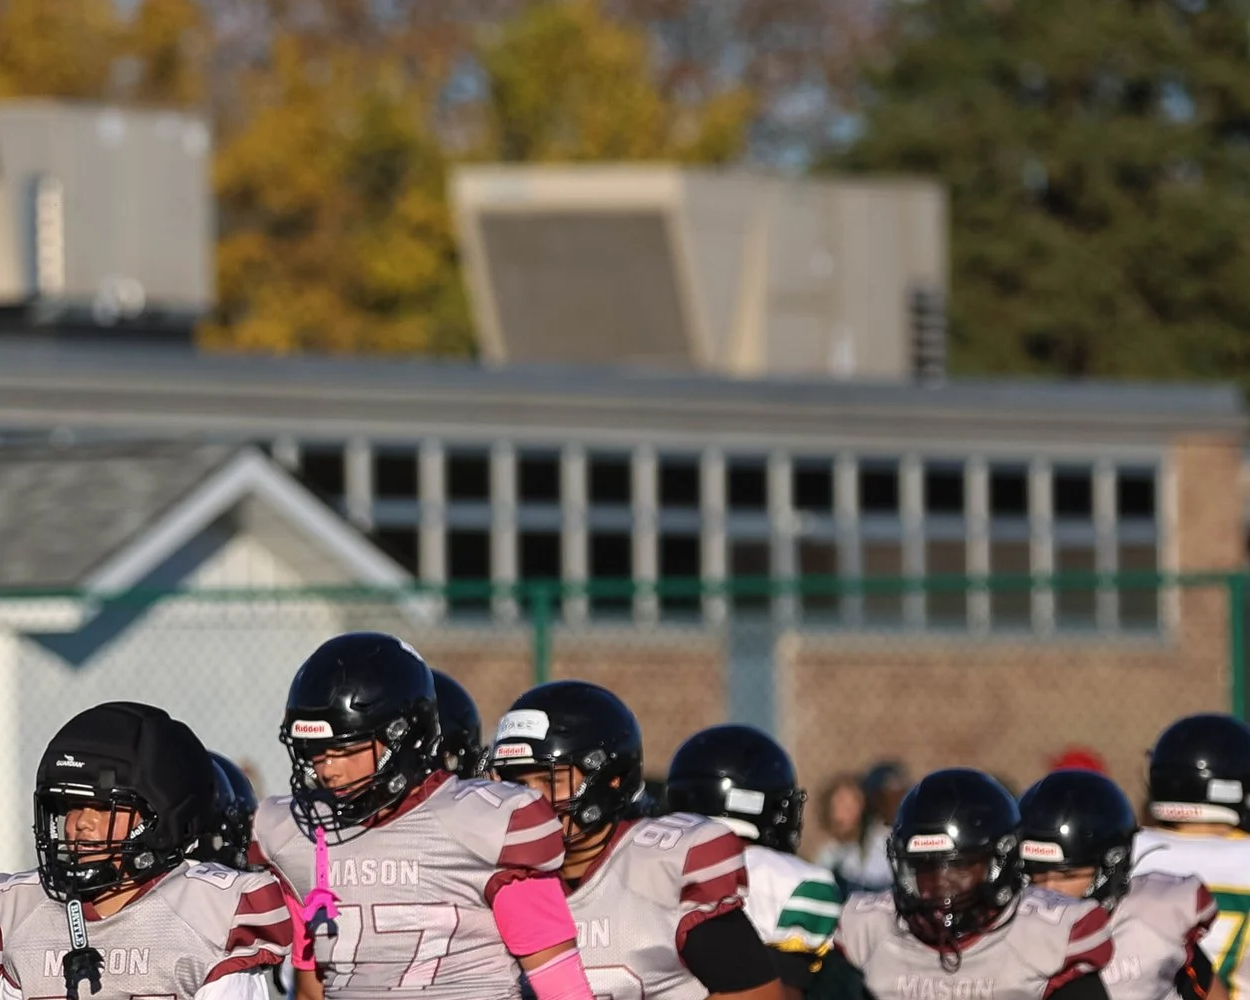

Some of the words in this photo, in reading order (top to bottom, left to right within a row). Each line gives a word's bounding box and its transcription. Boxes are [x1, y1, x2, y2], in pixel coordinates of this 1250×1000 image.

[295, 724, 325, 733] Riddell
[498, 747, 526, 757] Riddell
[70, 904, 84, 947] BATTLE
[316, 902, 460, 990] 77
[44, 947, 150, 977] MON
[897, 976, 996, 1000] MASON
